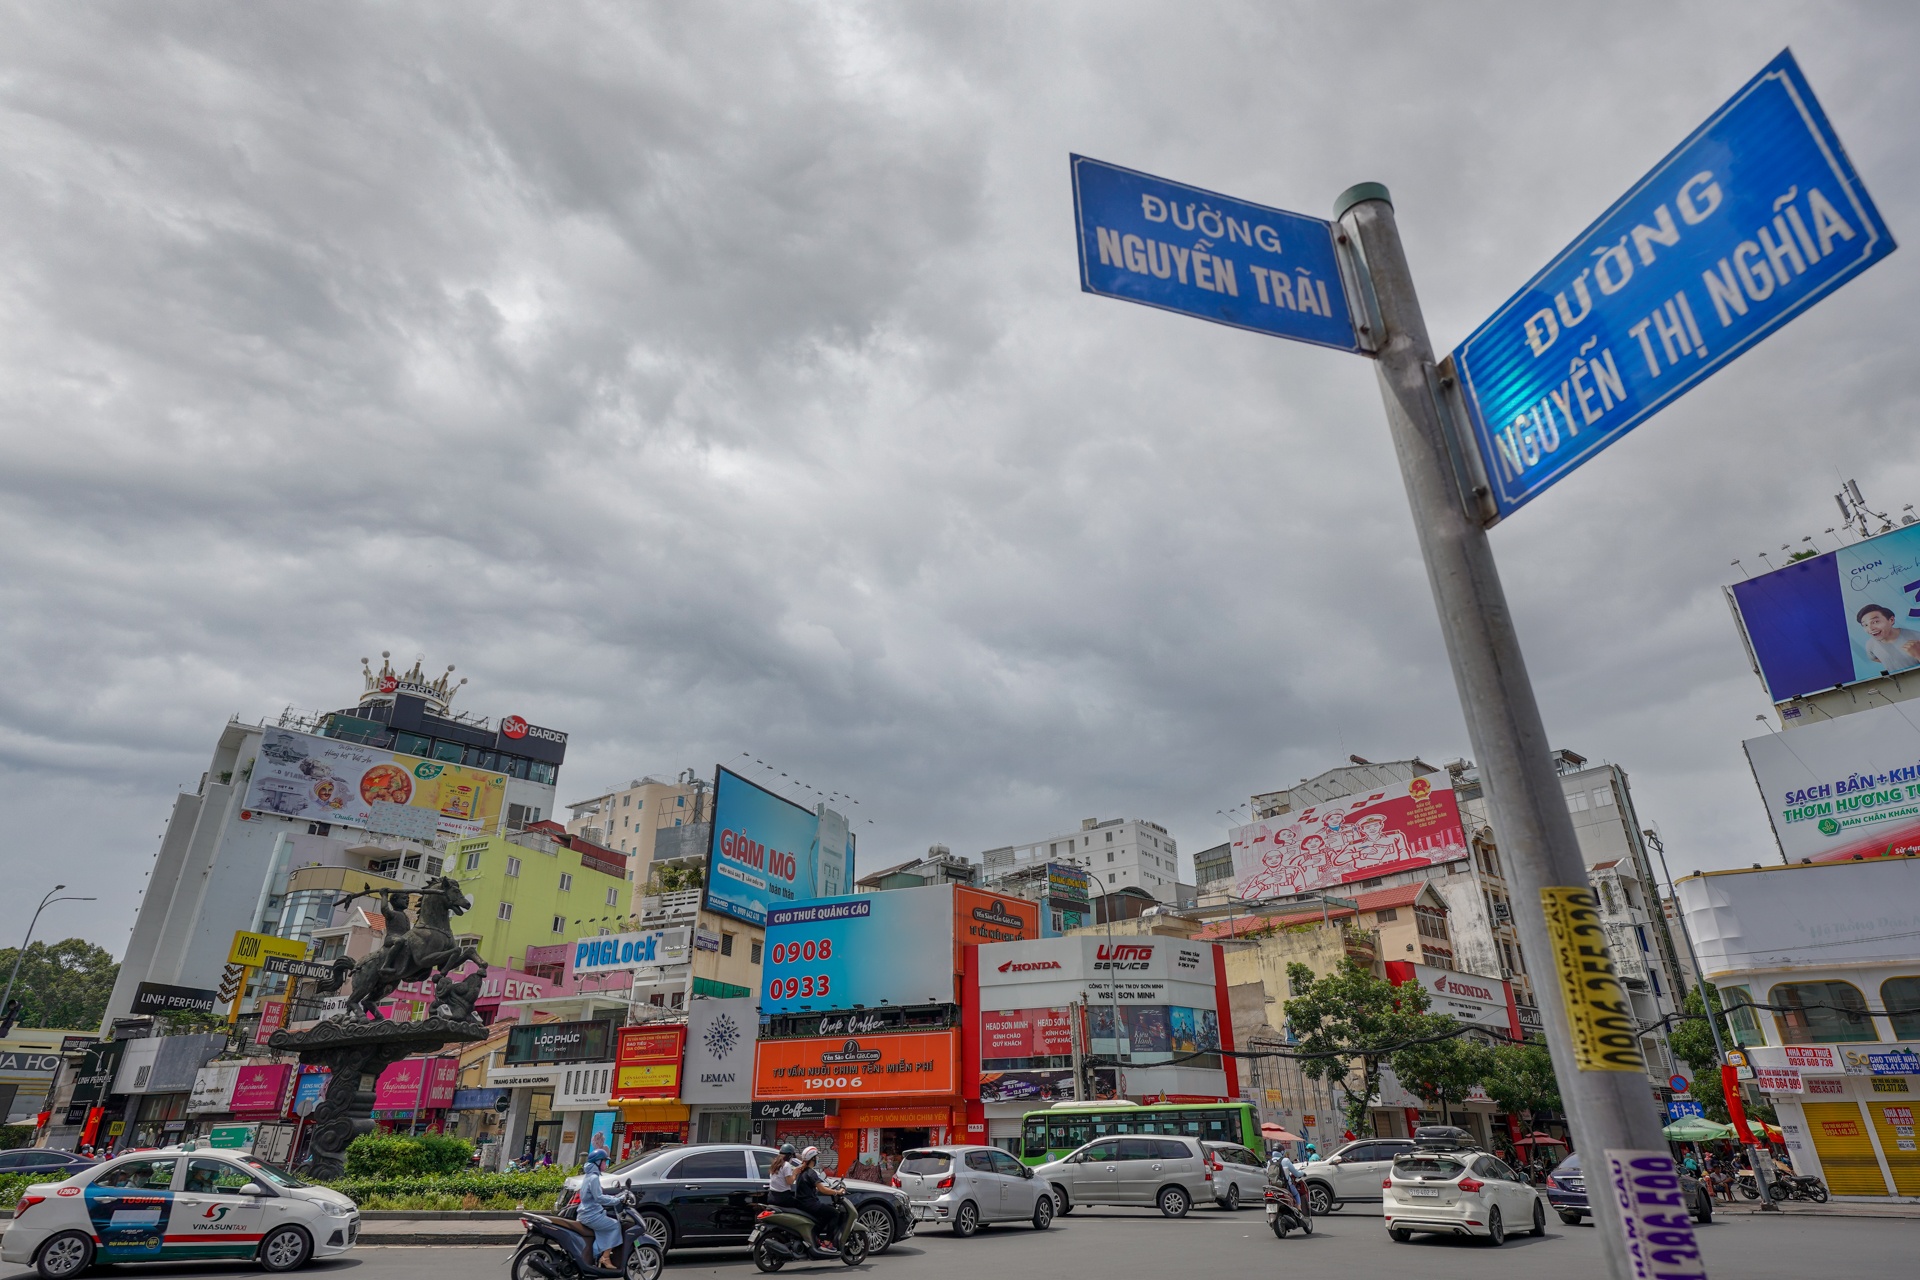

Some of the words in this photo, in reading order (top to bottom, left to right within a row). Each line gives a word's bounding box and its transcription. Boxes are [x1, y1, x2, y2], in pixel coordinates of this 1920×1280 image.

[1141, 193, 1283, 255] ĐƯỜNG
[1524, 170, 1725, 359] ĐƯỜNG
[1096, 226, 1240, 298] NGUYỄN
[1249, 264, 1333, 319] TRÃI
[1495, 334, 1628, 484] NGUYỄN
[1629, 290, 1709, 379] THỊ
[1702, 184, 1857, 328] NGHĨA
[398, 681, 447, 701] GARDEN
[503, 717, 528, 734] SKY
[528, 726, 569, 744] GARDEN
[1784, 783, 1832, 806] SẠCH
[1782, 800, 1832, 823] THƠM
[1835, 787, 1903, 813] HƯƠNG
[720, 828, 765, 870] GIẢM
[774, 911, 792, 924] CHO
[793, 907, 817, 921] THUÊ
[817, 903, 850, 919] QUẢNG
[850, 901, 869, 916] CÁO
[237, 935, 262, 958] ICON
[771, 937, 833, 965] 0908
[270, 959, 290, 970] THẾ
[289, 961, 306, 976] GIỚI
[306, 965, 330, 979] NƯỚC
[1010, 960, 1062, 972] HONDA
[504, 978, 543, 1000] EYES
[769, 973, 831, 1001] 0933
[1447, 981, 1494, 1001] HONDA
[140, 993, 166, 1005] LINH
[167, 996, 213, 1011] PERFUME
[1118, 991, 1135, 999] SƠN
[1137, 991, 1156, 999] MINH
[269, 1004, 281, 1015] THẾ
[265, 1015, 279, 1024] GIỚI
[819, 1017, 843, 1035] Cup
[848, 1015, 885, 1033] Coffee
[985, 1023, 1001, 1031] HEAD
[1001, 1021, 1012, 1030] SƠN
[1013, 1020, 1029, 1029] MINH
[1037, 1018, 1052, 1027] HEAD
[1053, 1017, 1066, 1027] SƠN
[534, 1033, 553, 1047] LỘC
[553, 1031, 580, 1044] PHÚC
[993, 1032, 1005, 1040] KÍNH
[1044, 1037, 1057, 1045] QUÝ
[992, 1040, 1004, 1048] QUÝ
[1004, 1039, 1022, 1047] KHÁCH
[1786, 1048, 1800, 1057] NHÀ
[1800, 1048, 1814, 1057] CHO
[1814, 1048, 1831, 1058] THUÊ
[1869, 1056, 1884, 1064] CHO
[1883, 1054, 1903, 1064] THUÊ
[1902, 1053, 1918, 1063] NHÀ
[773, 1067, 786, 1077] TƯ
[787, 1064, 806, 1077] VẤN
[807, 1064, 831, 1076] NUÔI
[833, 1064, 858, 1076] CHIM
[886, 1059, 912, 1073] MIỄN
[915, 1059, 933, 1072] PHÍ
[1788, 1058, 1806, 1066] 0938
[1819, 1058, 1834, 1067] 739
[509, 1077, 518, 1085] SỨC
[700, 1072, 736, 1083] LEMAN
[804, 1077, 847, 1090] 1900
[850, 1076, 863, 1088] 6
[1759, 1077, 1775, 1089] 0916
[1774, 1077, 1789, 1089] 664
[1787, 1078, 1802, 1090] 999
[70, 1109, 84, 1117] LINH
[761, 1104, 780, 1118] Cup
[781, 1103, 813, 1117] Coffee
[916, 1113, 934, 1121] CHIM
[933, 1111, 947, 1121] YẾN
[1883, 1108, 1898, 1117] NHÀ
[1898, 1107, 1912, 1117] BÁN
[843, 1131, 854, 1140] YẾN
[843, 1140, 854, 1149] SÀO
[122, 1196, 166, 1204] TOSHIBA
